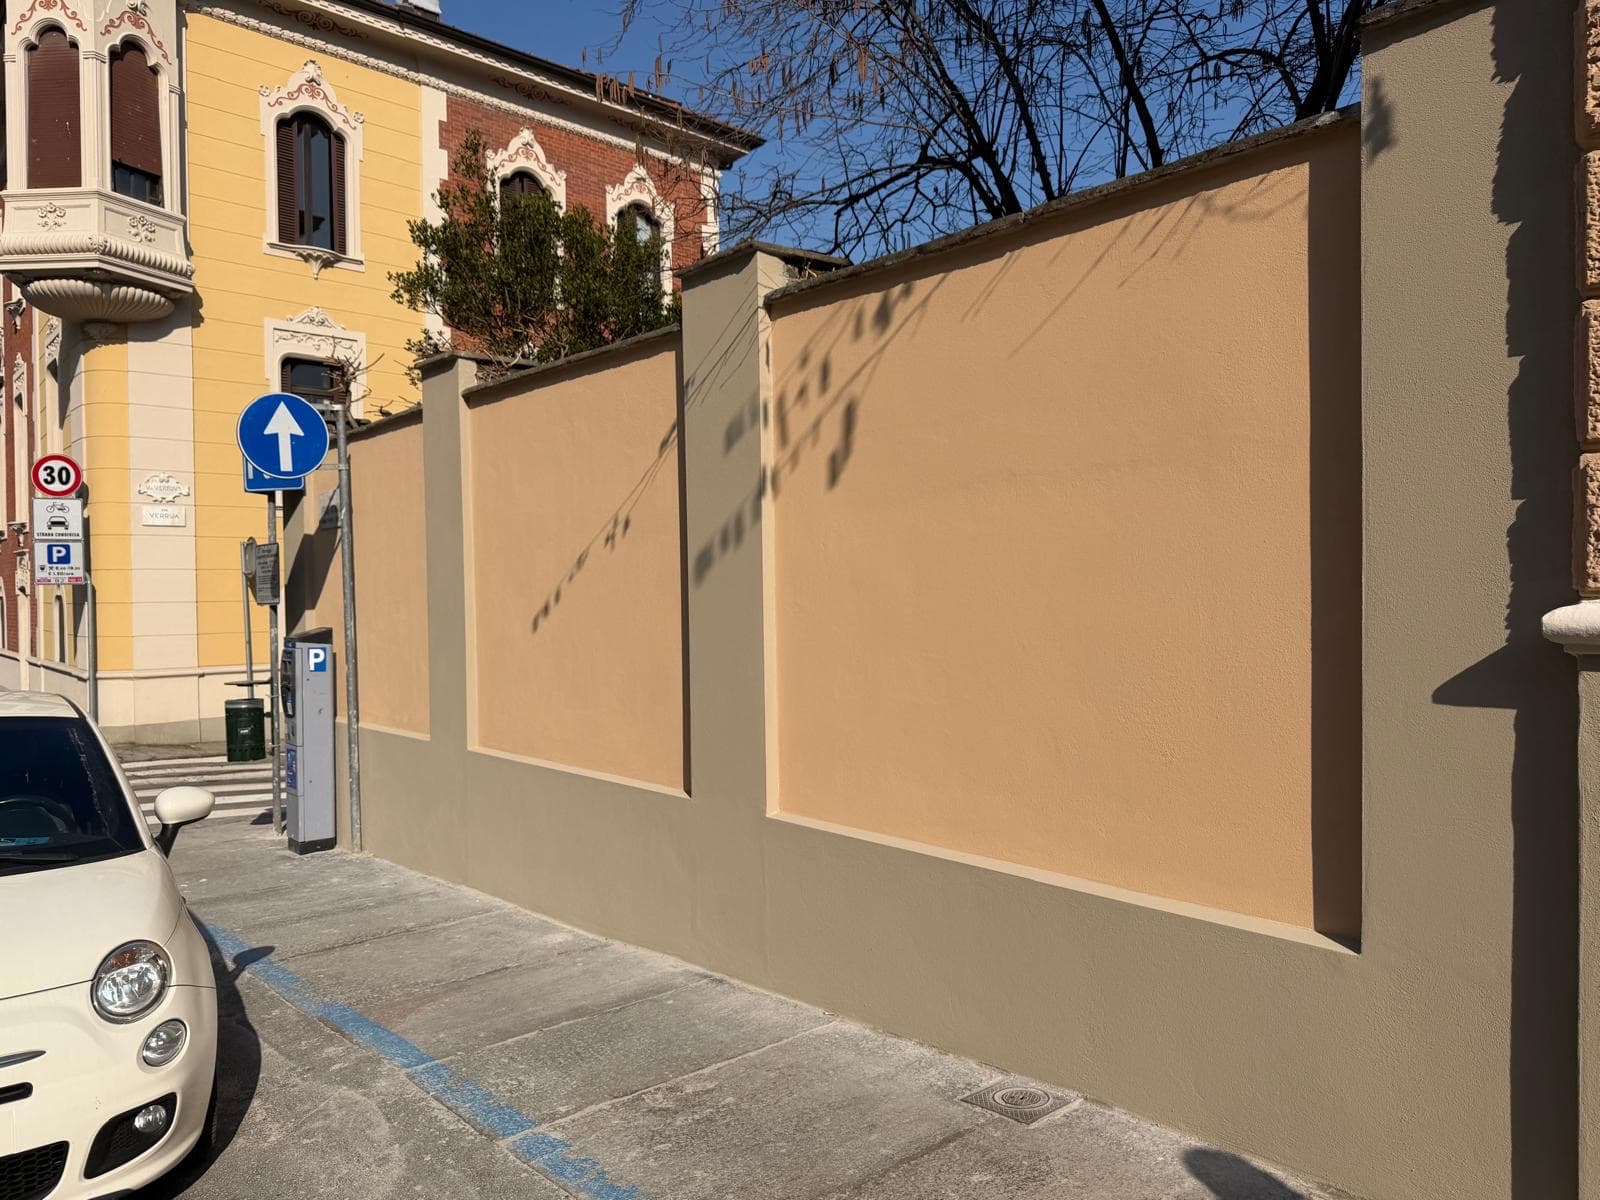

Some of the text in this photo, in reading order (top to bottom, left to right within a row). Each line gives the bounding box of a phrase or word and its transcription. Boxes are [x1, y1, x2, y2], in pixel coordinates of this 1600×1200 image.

[43, 465, 71, 485] 30
[52, 546, 67, 562] P
[309, 648, 325, 671] P
